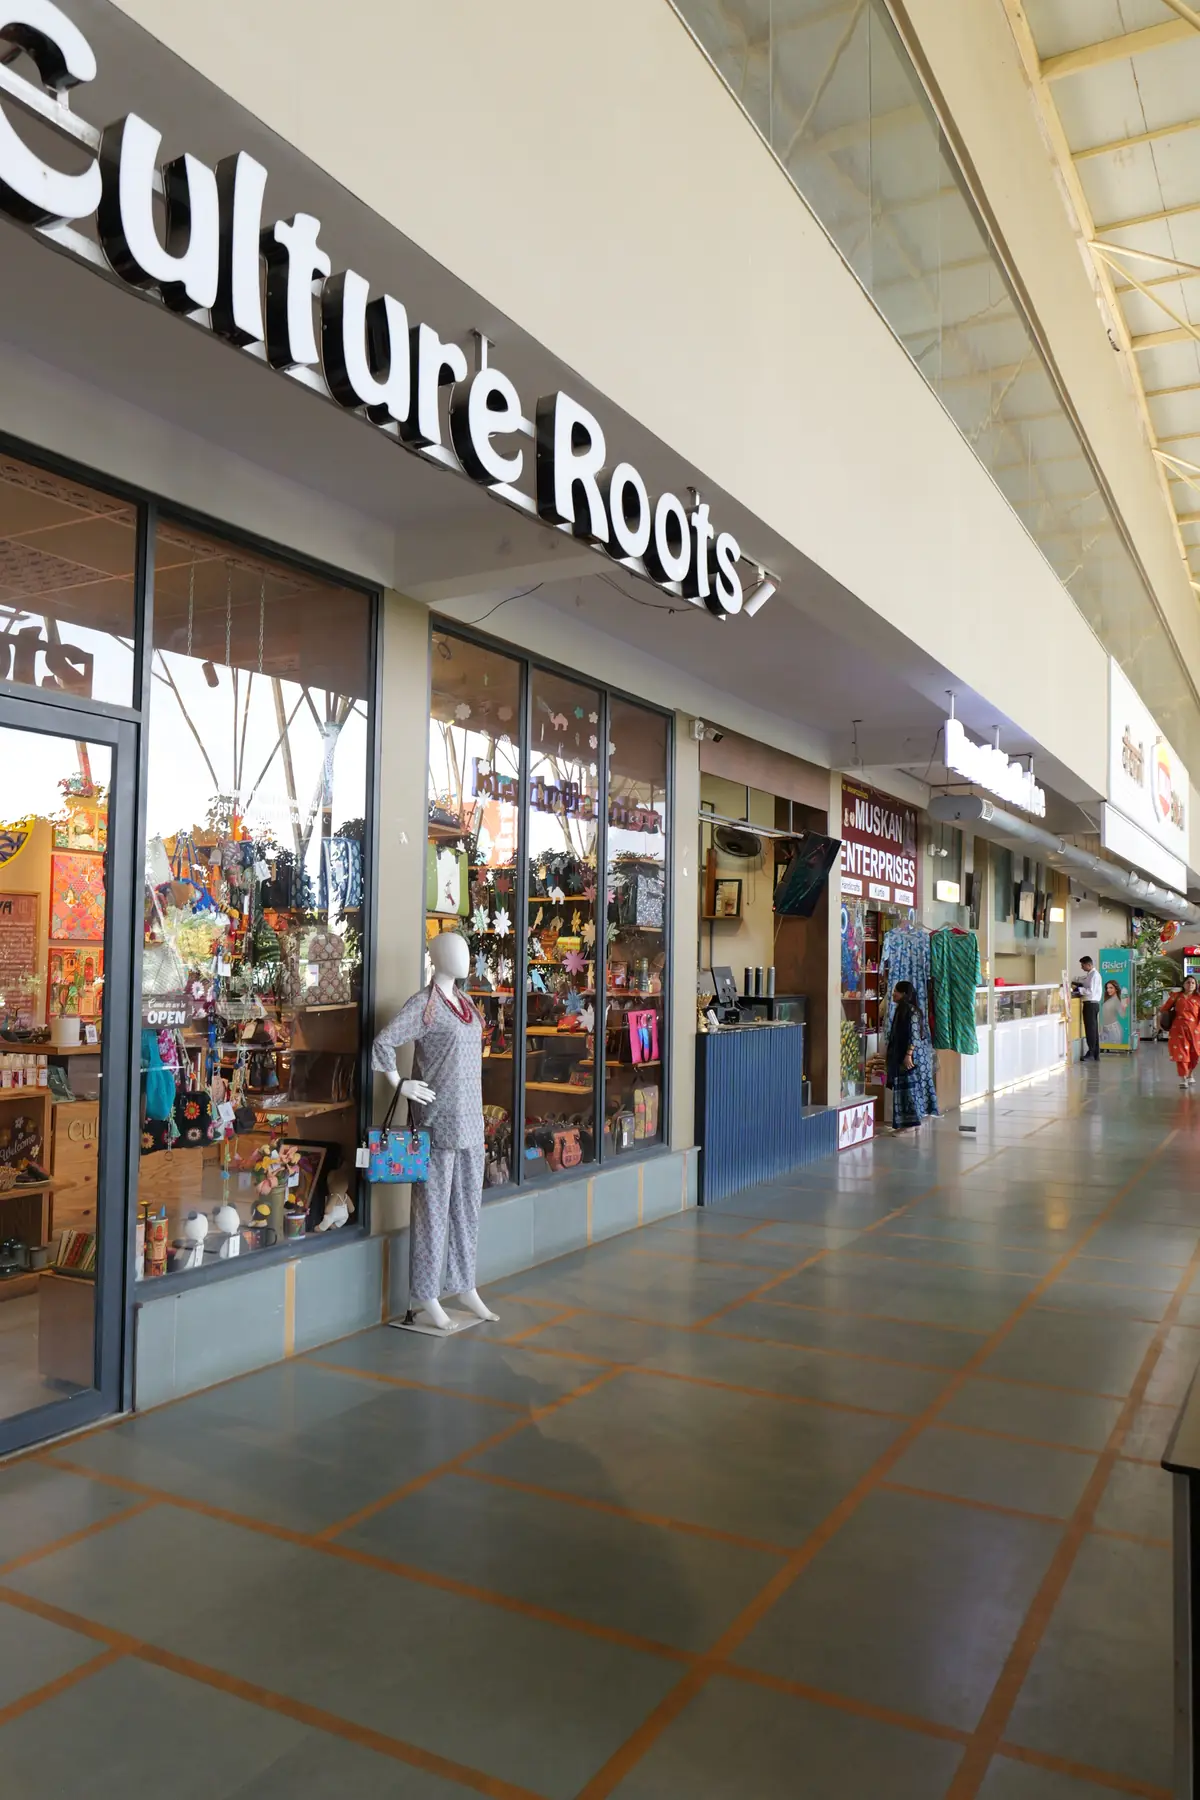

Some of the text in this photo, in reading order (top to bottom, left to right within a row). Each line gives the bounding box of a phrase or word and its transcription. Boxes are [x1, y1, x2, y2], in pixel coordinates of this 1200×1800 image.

[0, 0, 744, 615] Culture Roots
[855, 798, 903, 844] MUSKAN
[841, 839, 916, 888] ENTERPRISES
[147, 1010, 186, 1025] OPEN
[0, 1134, 37, 1161] Welcome
